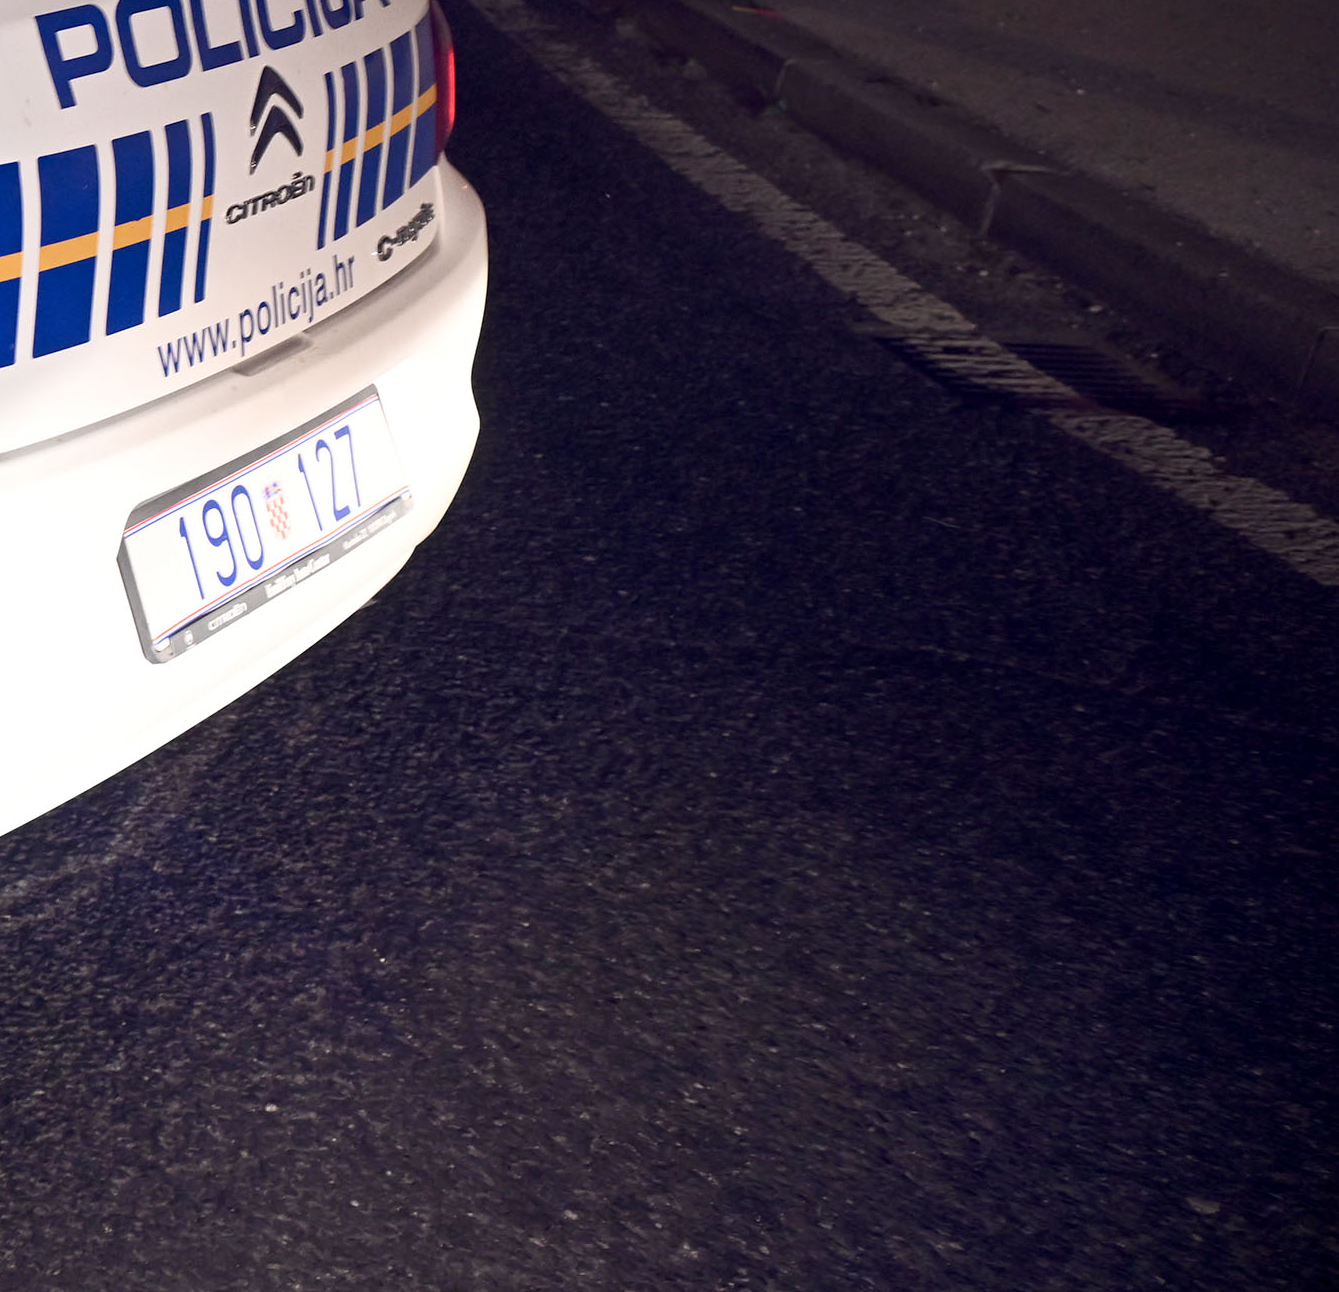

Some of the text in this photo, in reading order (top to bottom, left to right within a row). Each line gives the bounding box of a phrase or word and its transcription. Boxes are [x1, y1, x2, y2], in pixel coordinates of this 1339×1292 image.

[157, 254, 355, 378] www.policija.hr
[179, 484, 265, 600] 190
[298, 425, 361, 531] 127
